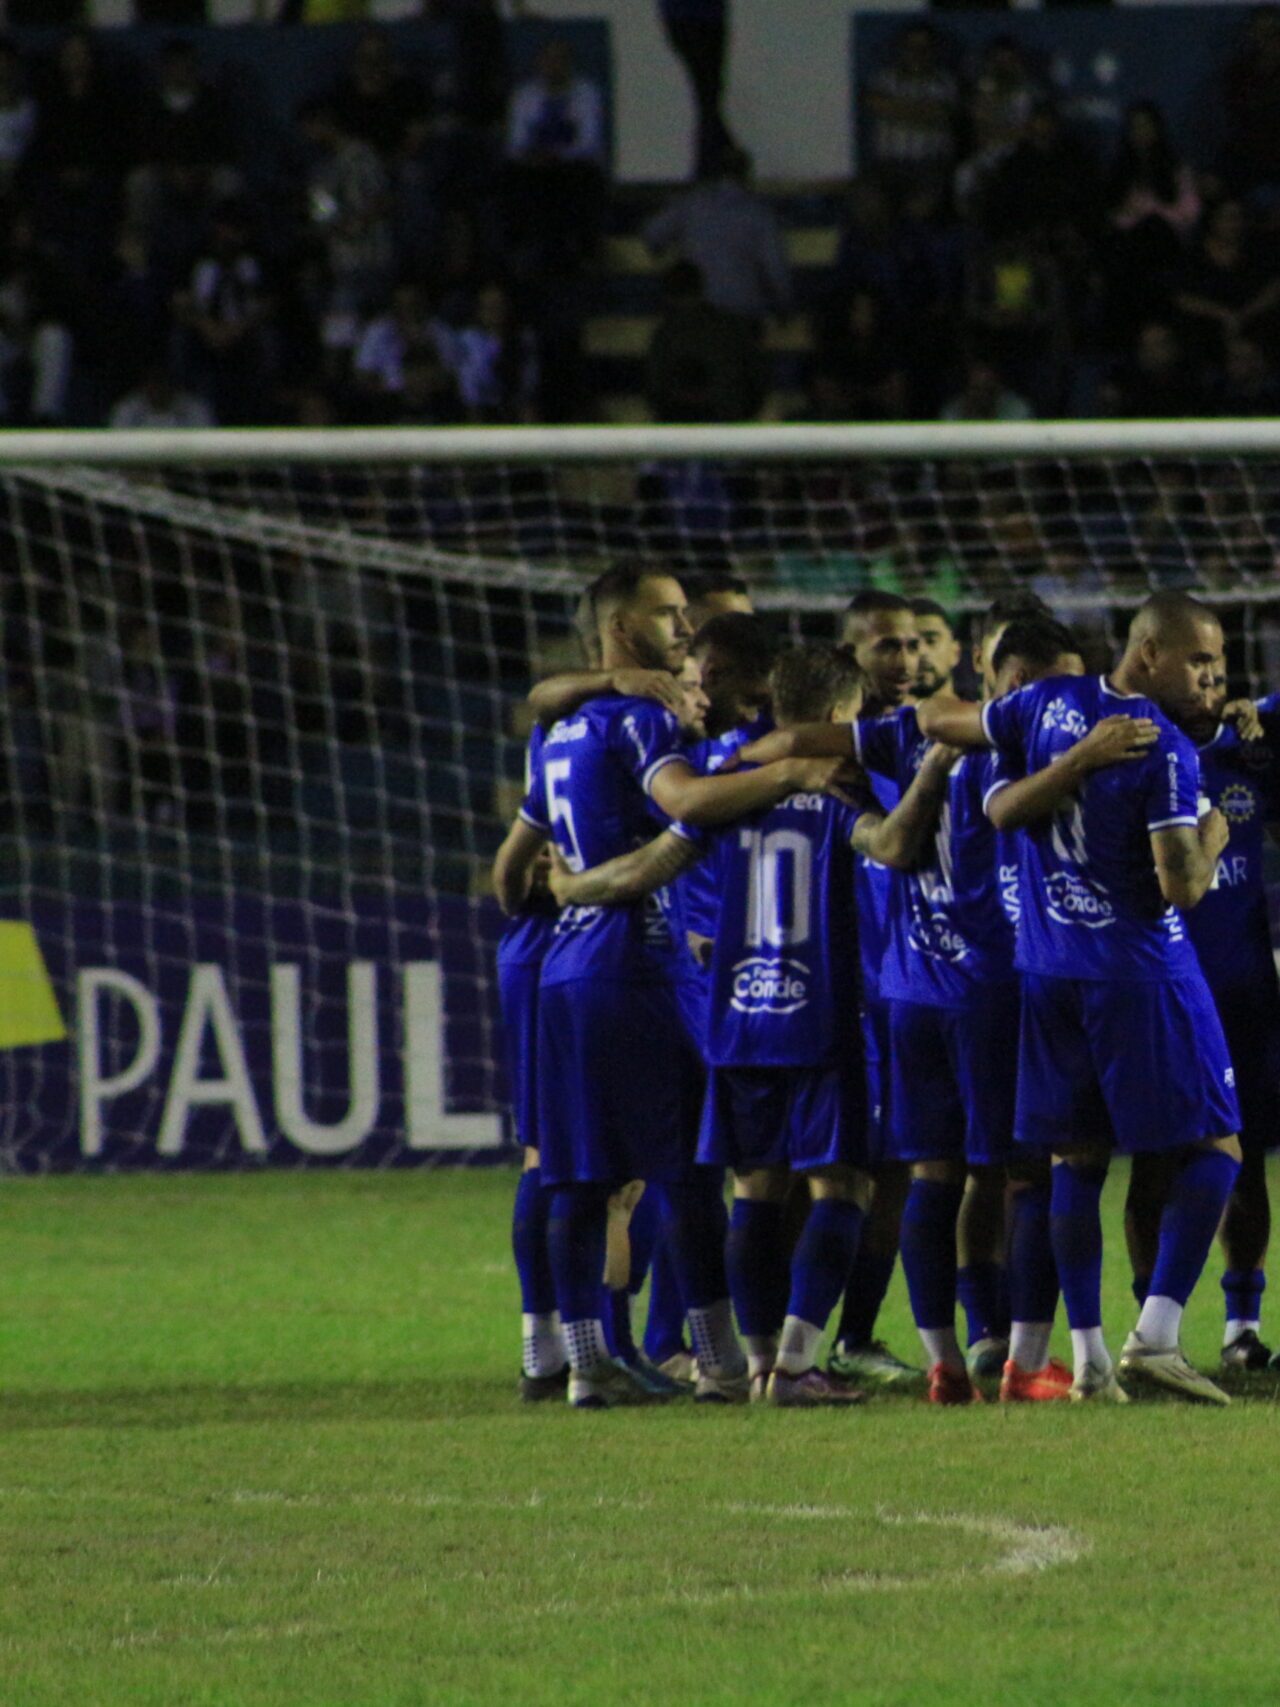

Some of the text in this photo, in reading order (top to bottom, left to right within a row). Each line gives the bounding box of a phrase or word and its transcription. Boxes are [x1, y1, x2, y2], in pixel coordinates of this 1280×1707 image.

[544, 757, 587, 874] 5
[738, 829, 813, 948] 10
[734, 972, 806, 1000] Conde
